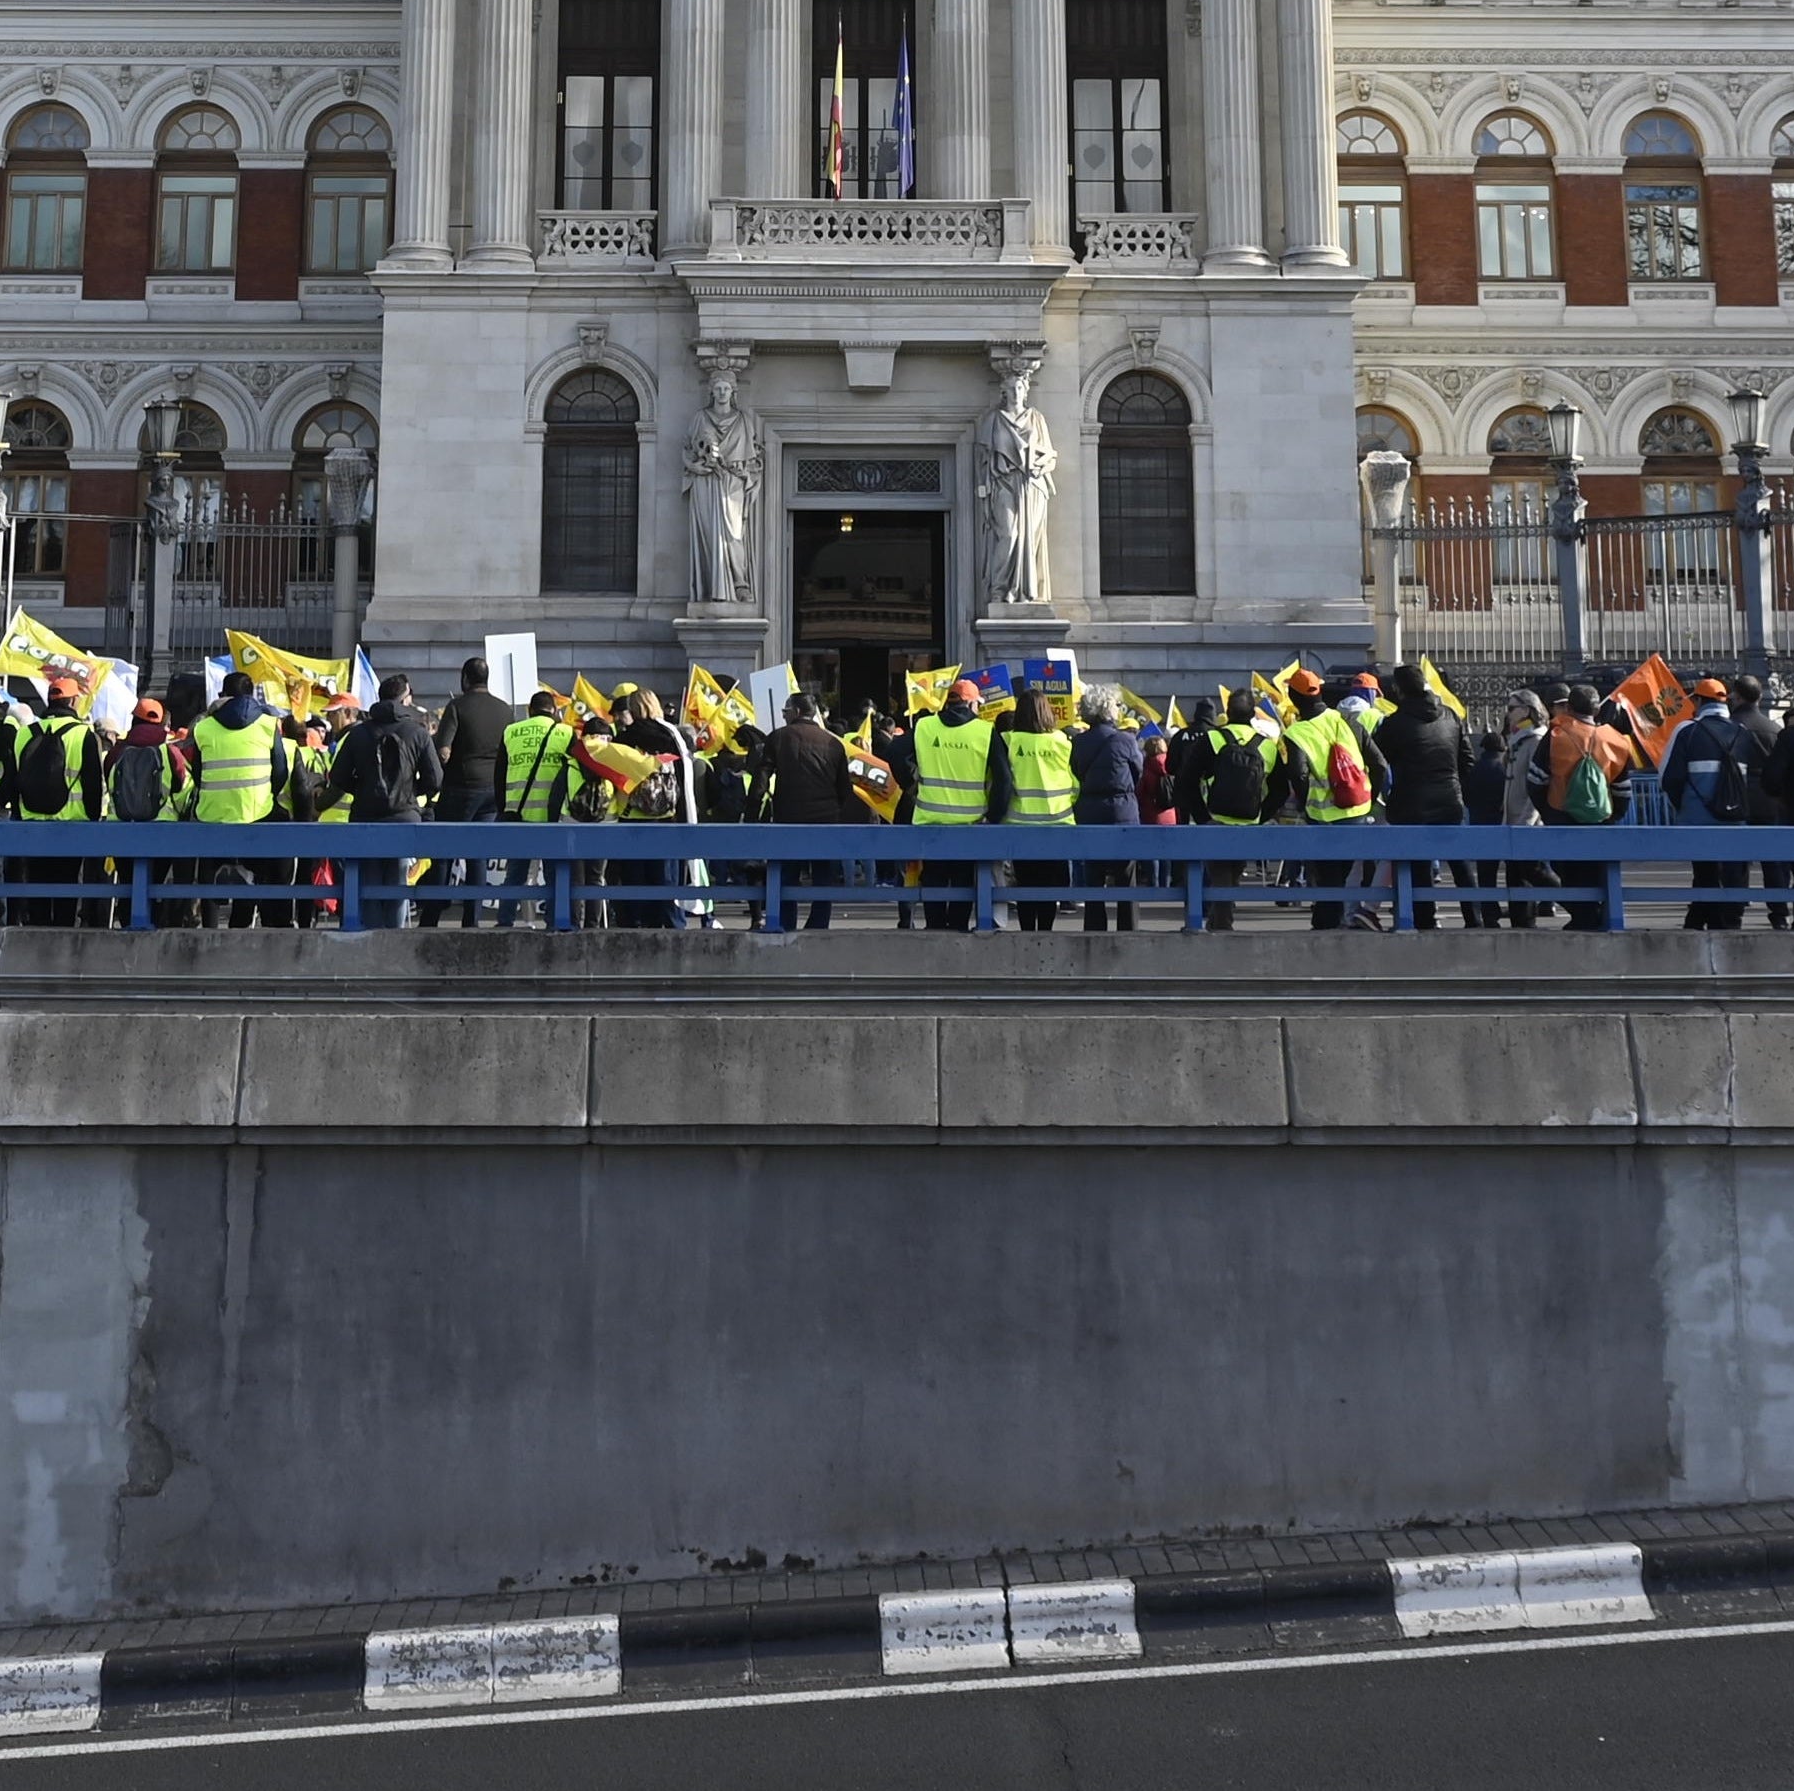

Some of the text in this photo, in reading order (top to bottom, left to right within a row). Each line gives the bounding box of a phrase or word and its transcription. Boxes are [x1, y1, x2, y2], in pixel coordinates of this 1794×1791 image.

[8, 634, 89, 678] COAG
[1046, 680, 1069, 692] AGUA
[510, 725, 548, 739] NUESTRO
